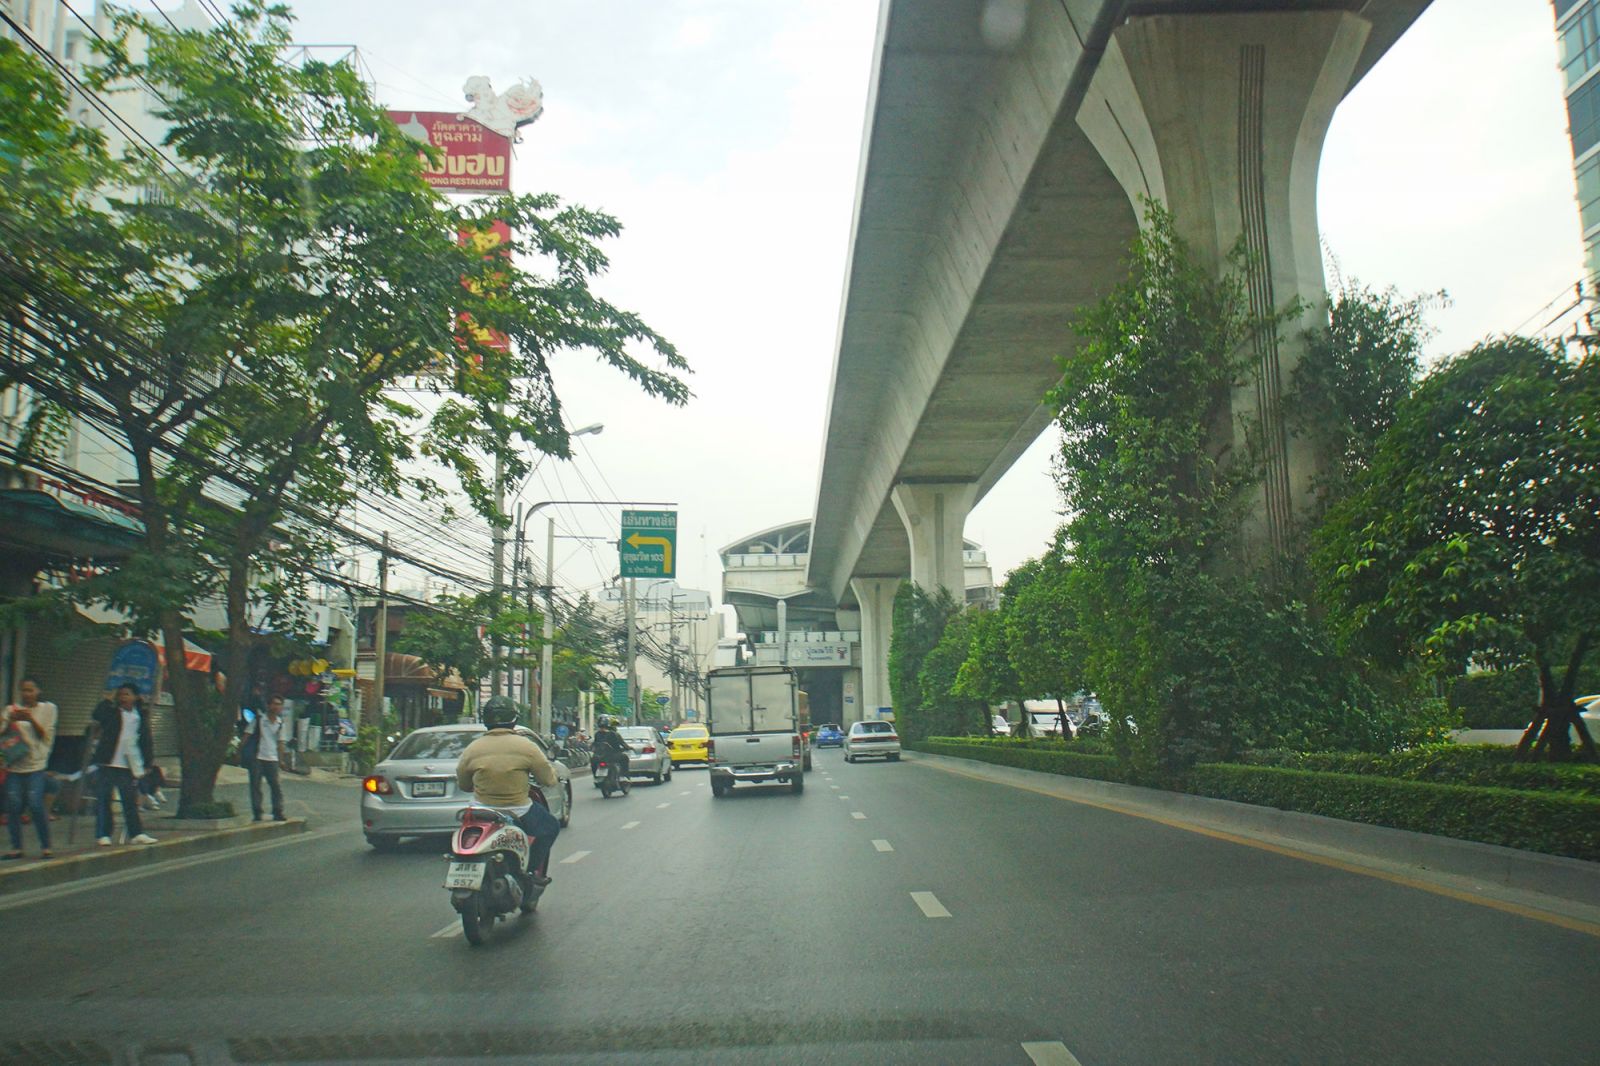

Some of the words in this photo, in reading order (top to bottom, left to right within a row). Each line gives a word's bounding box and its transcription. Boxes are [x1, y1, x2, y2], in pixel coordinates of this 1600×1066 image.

[432, 120, 483, 132] ภัตตาคาร
[432, 132, 482, 146] หูฉลาม
[450, 177, 504, 187] RESTAURANT
[623, 512, 676, 527] เส้นทางลัด
